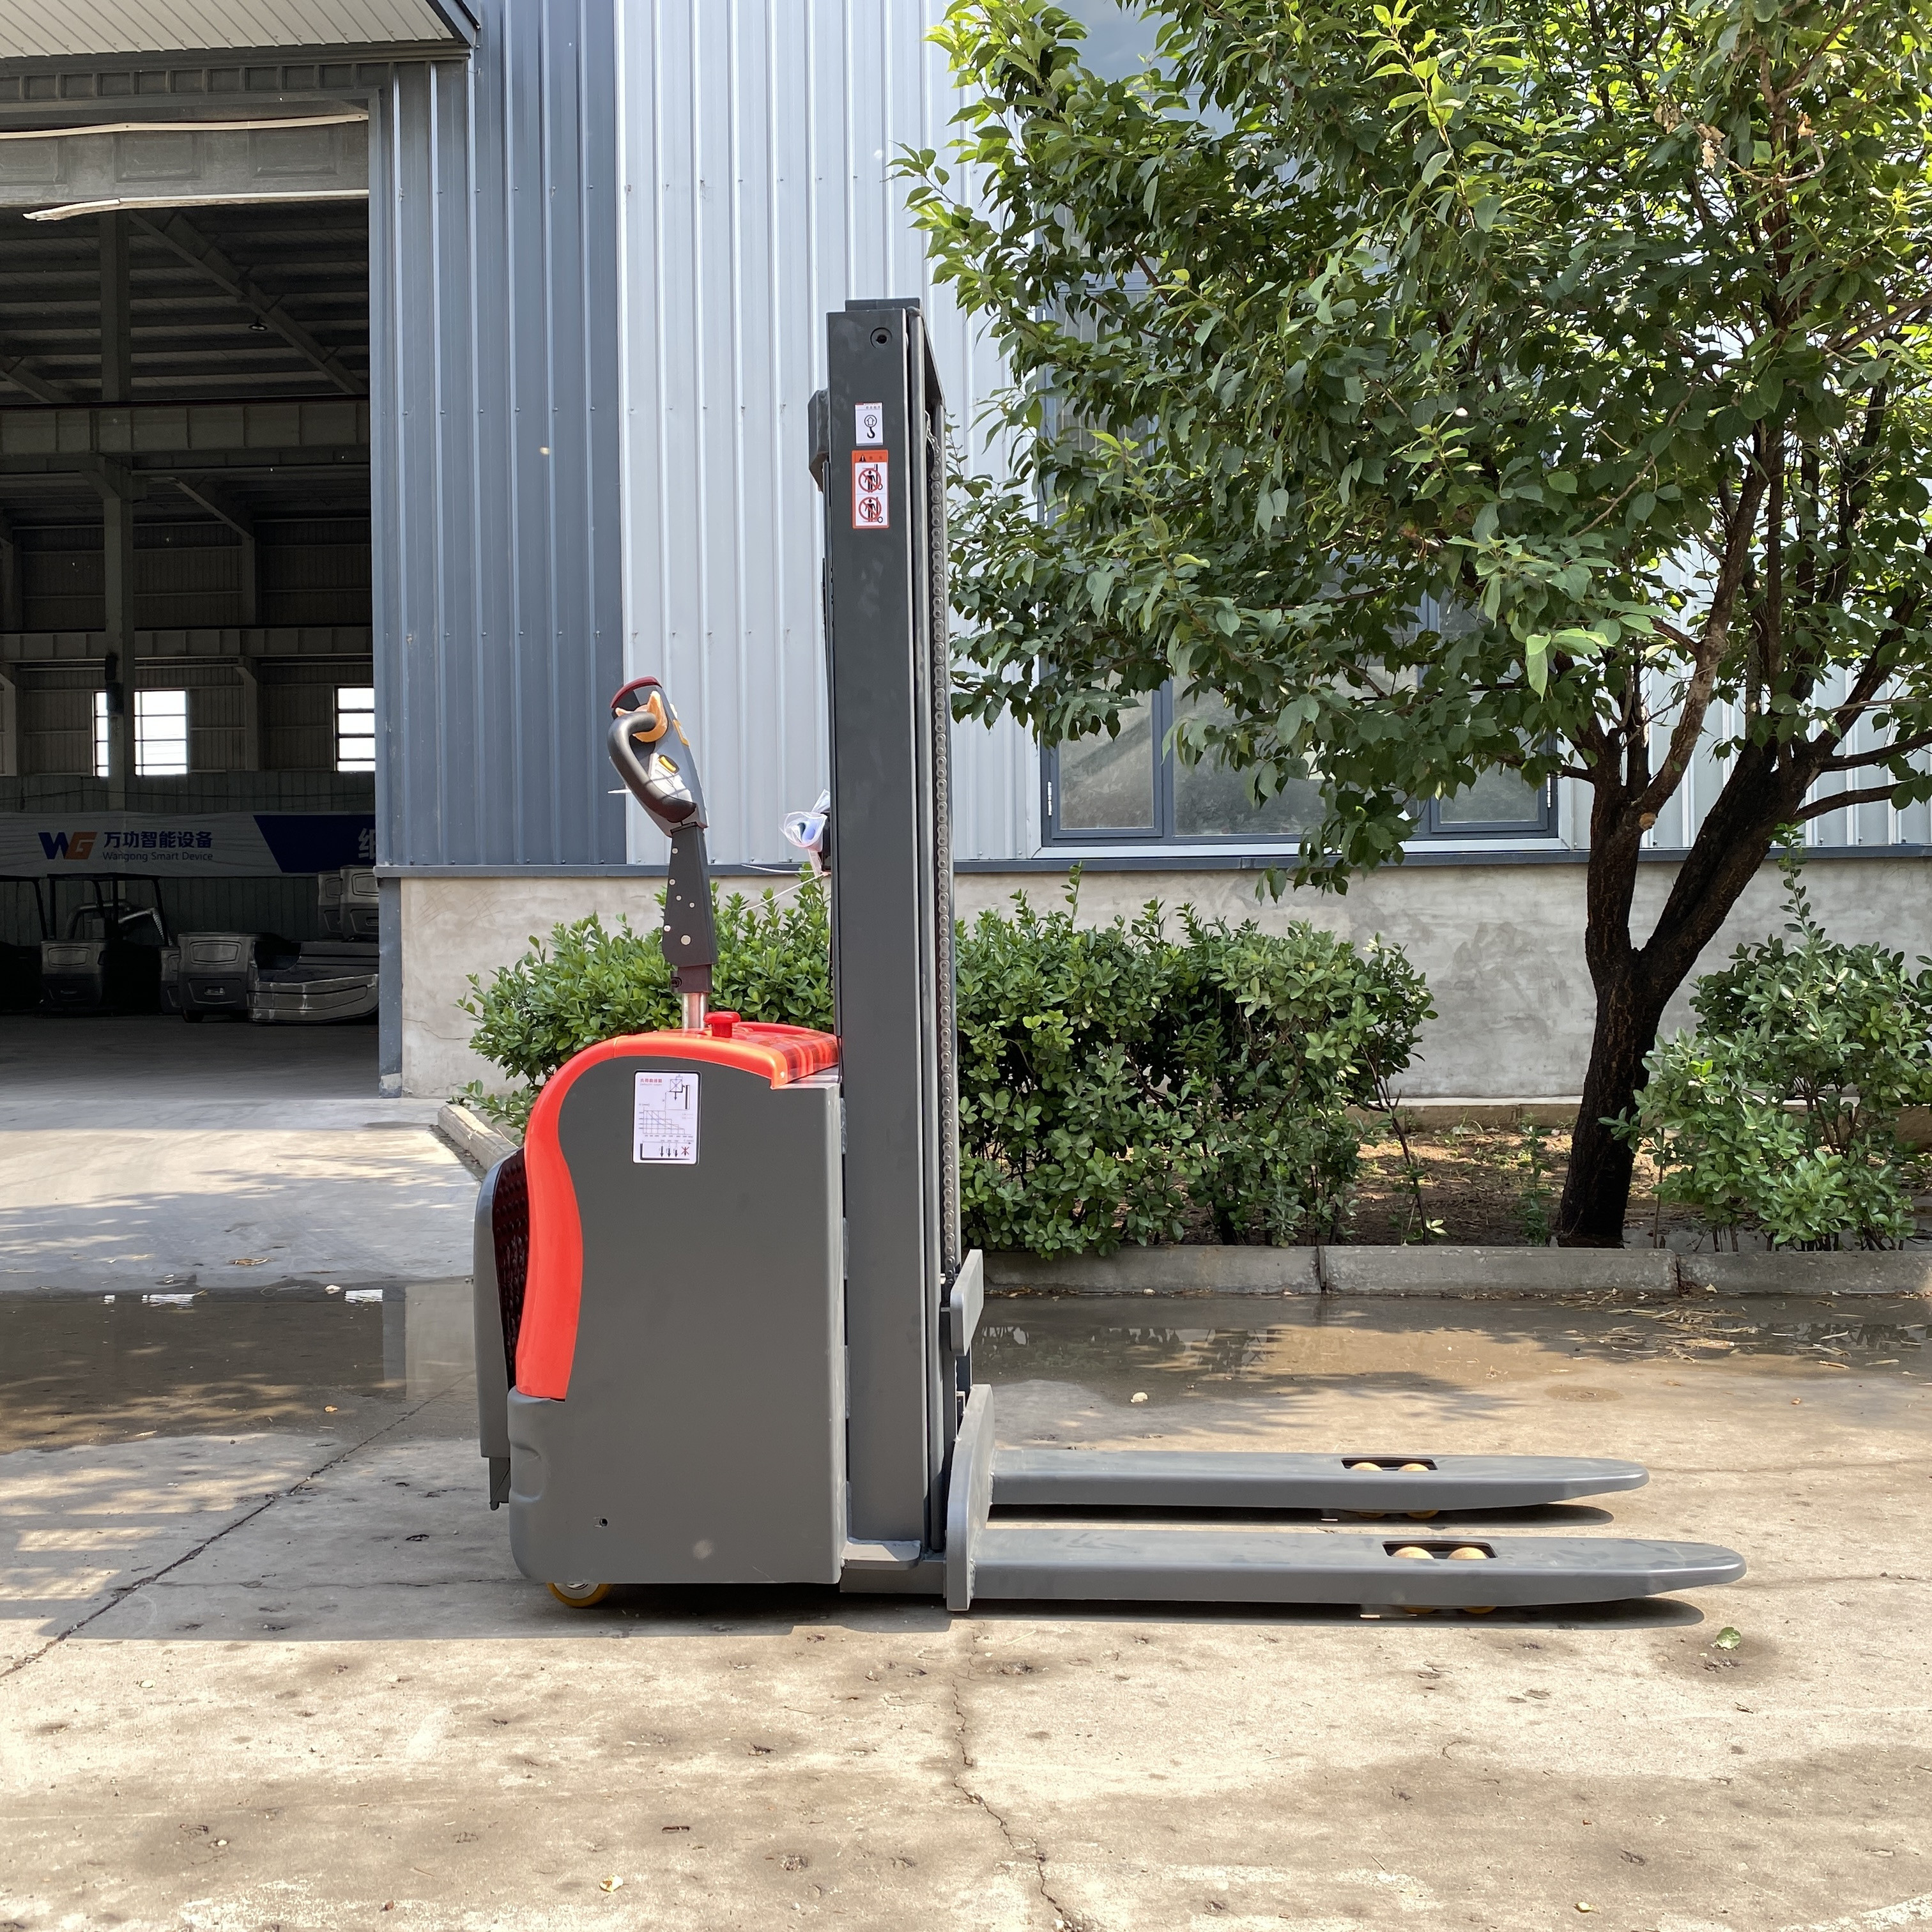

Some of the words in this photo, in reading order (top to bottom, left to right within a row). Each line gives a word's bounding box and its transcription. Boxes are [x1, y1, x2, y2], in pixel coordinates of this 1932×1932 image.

[38, 832, 98, 860] WG
[103, 831, 213, 848] 万功智能设备
[103, 852, 148, 862] Wangong
[151, 852, 179, 861] Smart
[182, 852, 213, 861] Device
